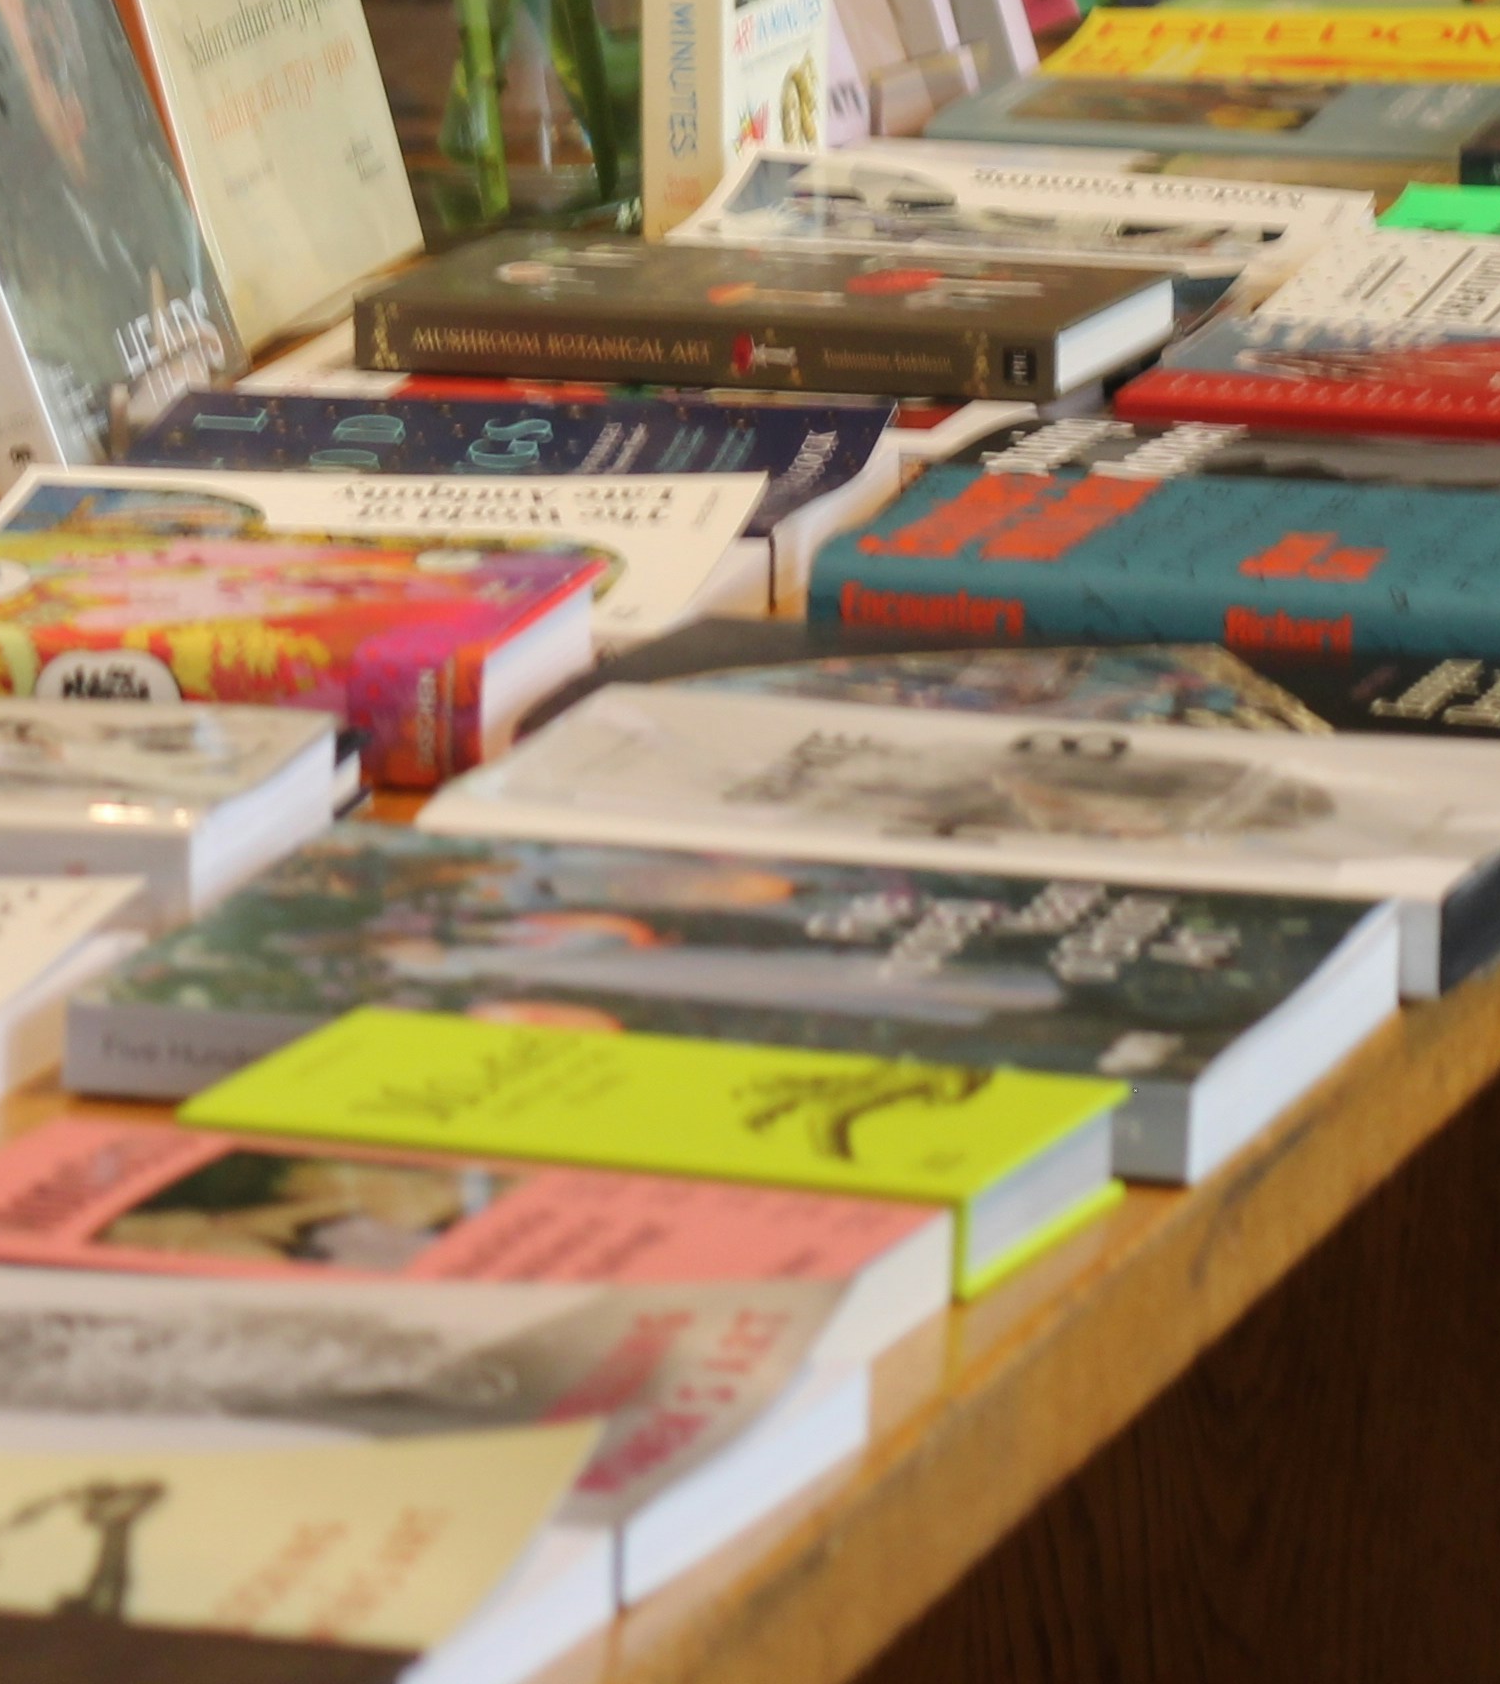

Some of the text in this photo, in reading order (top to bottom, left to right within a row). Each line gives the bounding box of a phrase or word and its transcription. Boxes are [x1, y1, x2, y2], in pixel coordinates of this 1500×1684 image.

[668, 4, 699, 162] MINUTES
[112, 284, 228, 381] HEADS
[411, 325, 712, 366] MUSHROOM BOTANICAL ART
[839, 579, 1026, 639] Encounters
[1224, 605, 1354, 654] Richard
